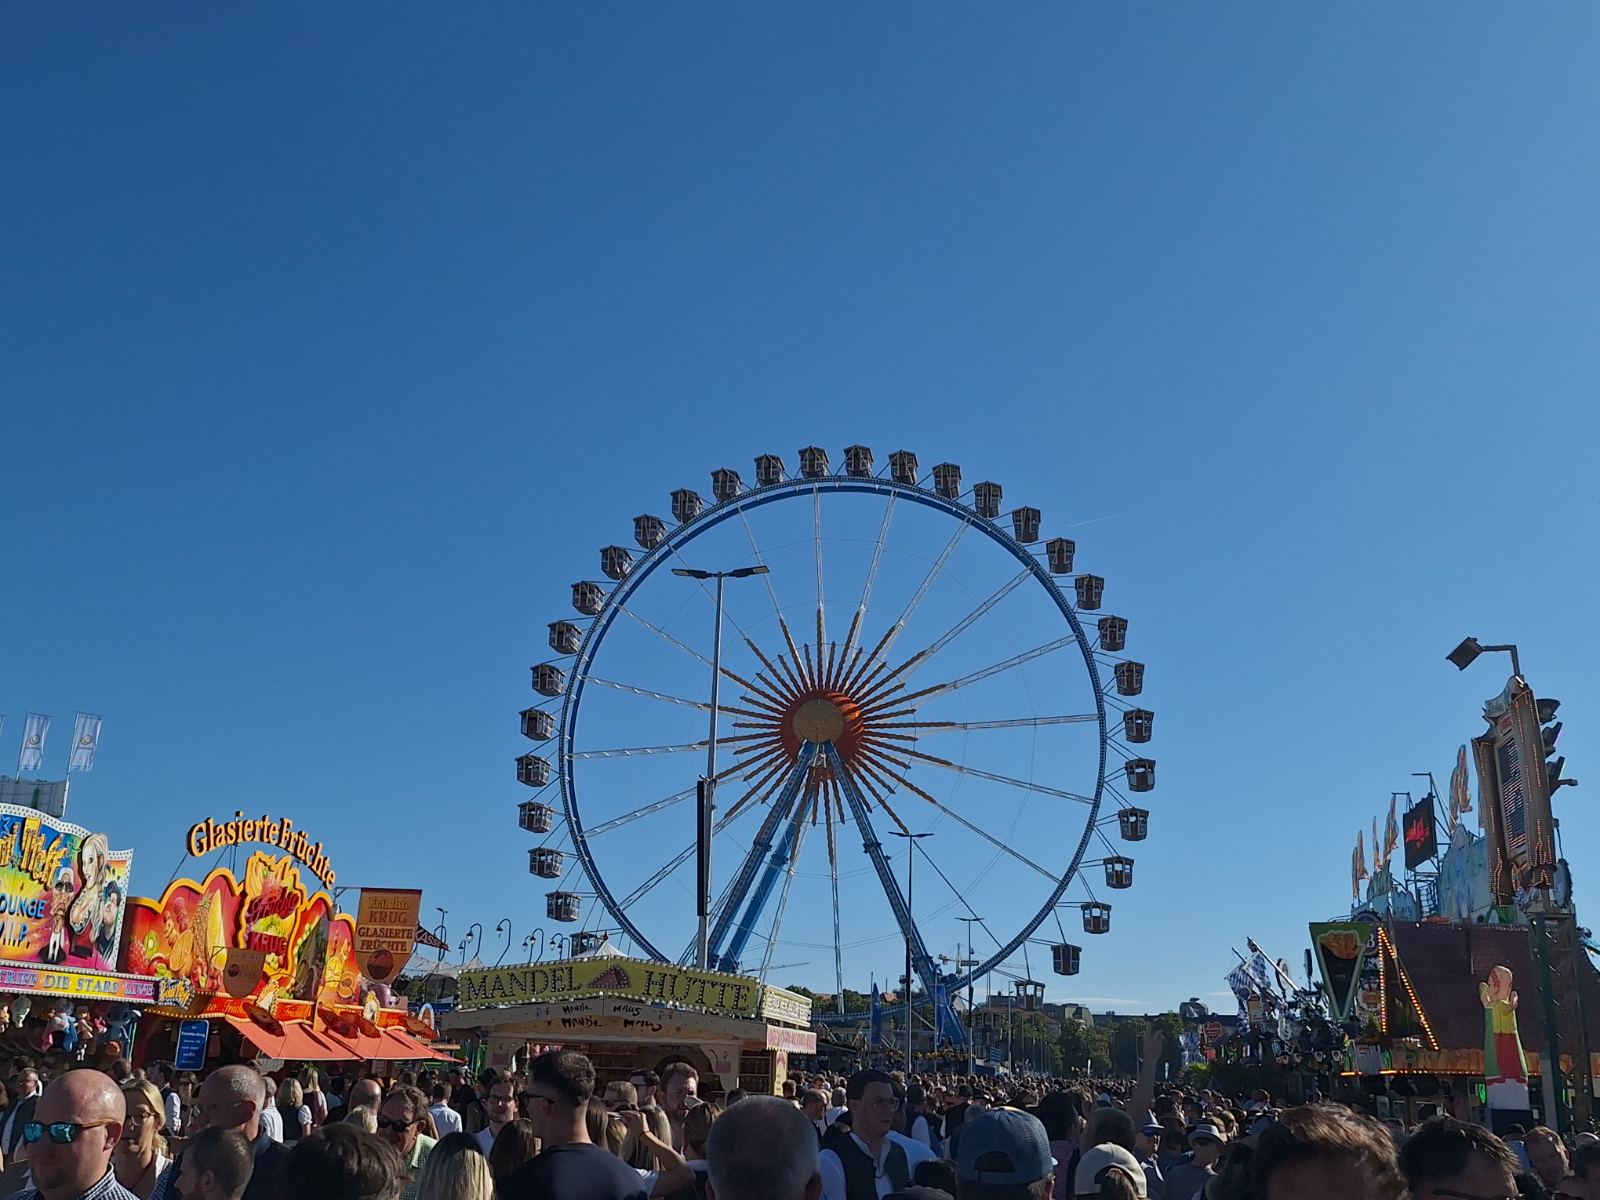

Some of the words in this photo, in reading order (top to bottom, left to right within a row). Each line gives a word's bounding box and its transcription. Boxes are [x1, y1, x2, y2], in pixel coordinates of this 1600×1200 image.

[187, 811, 279, 857] Glasierte
[280, 817, 336, 890] Früchte
[369, 911, 408, 923] KRUG
[358, 927, 413, 939] GLASIERTE
[360, 939, 408, 951] FRÜCHTE
[44, 975, 70, 989] DIE
[77, 978, 120, 994] STARS
[124, 982, 155, 996] LIVE
[463, 966, 582, 1000] MANDEL
[642, 968, 750, 1011] HÜTTE
